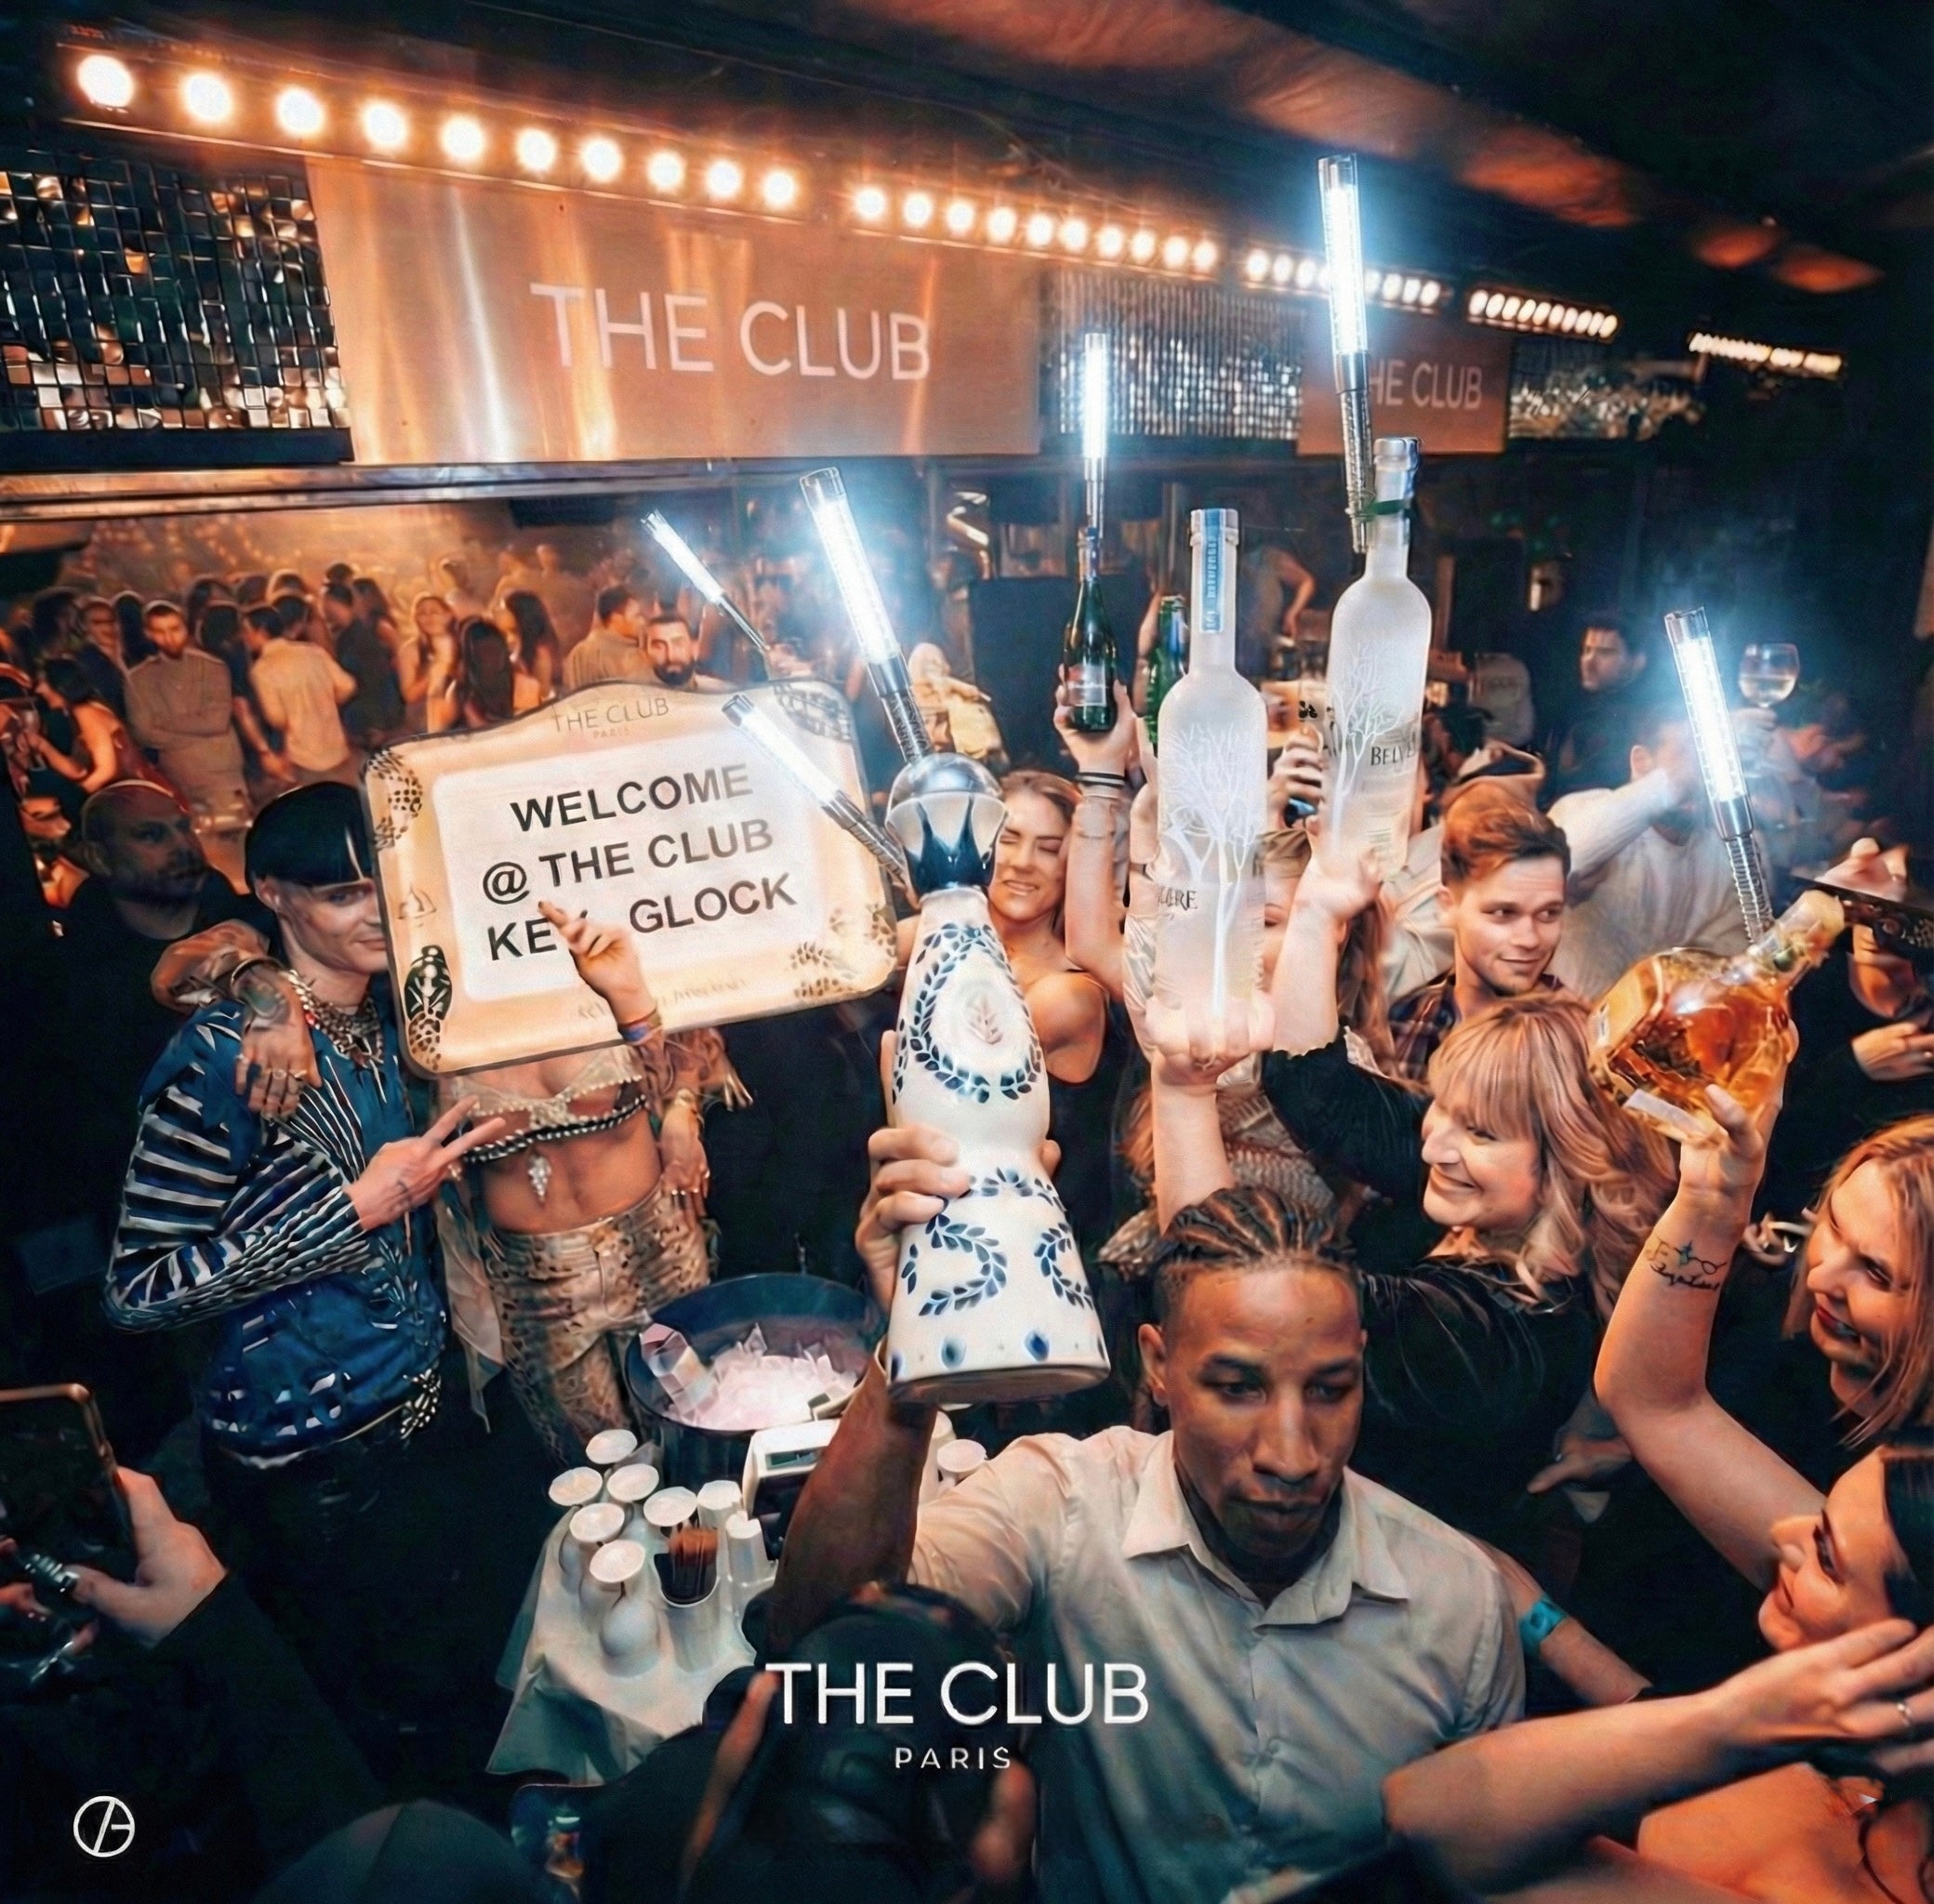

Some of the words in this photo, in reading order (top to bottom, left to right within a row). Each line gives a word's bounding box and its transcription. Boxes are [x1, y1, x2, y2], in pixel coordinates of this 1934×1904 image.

[529, 283, 715, 372] THE
[740, 300, 931, 380] CLUB
[1369, 357, 1405, 407] HE
[1411, 362, 1483, 410] CLUB
[550, 705, 599, 734] THE
[606, 697, 669, 723] CLUB
[510, 765, 753, 832] WELCOME
[483, 861, 530, 905] @
[538, 841, 634, 887] THE
[648, 818, 774, 868] CLUB
[487, 908, 588, 960] KE
[629, 872, 797, 933] GLOCK
